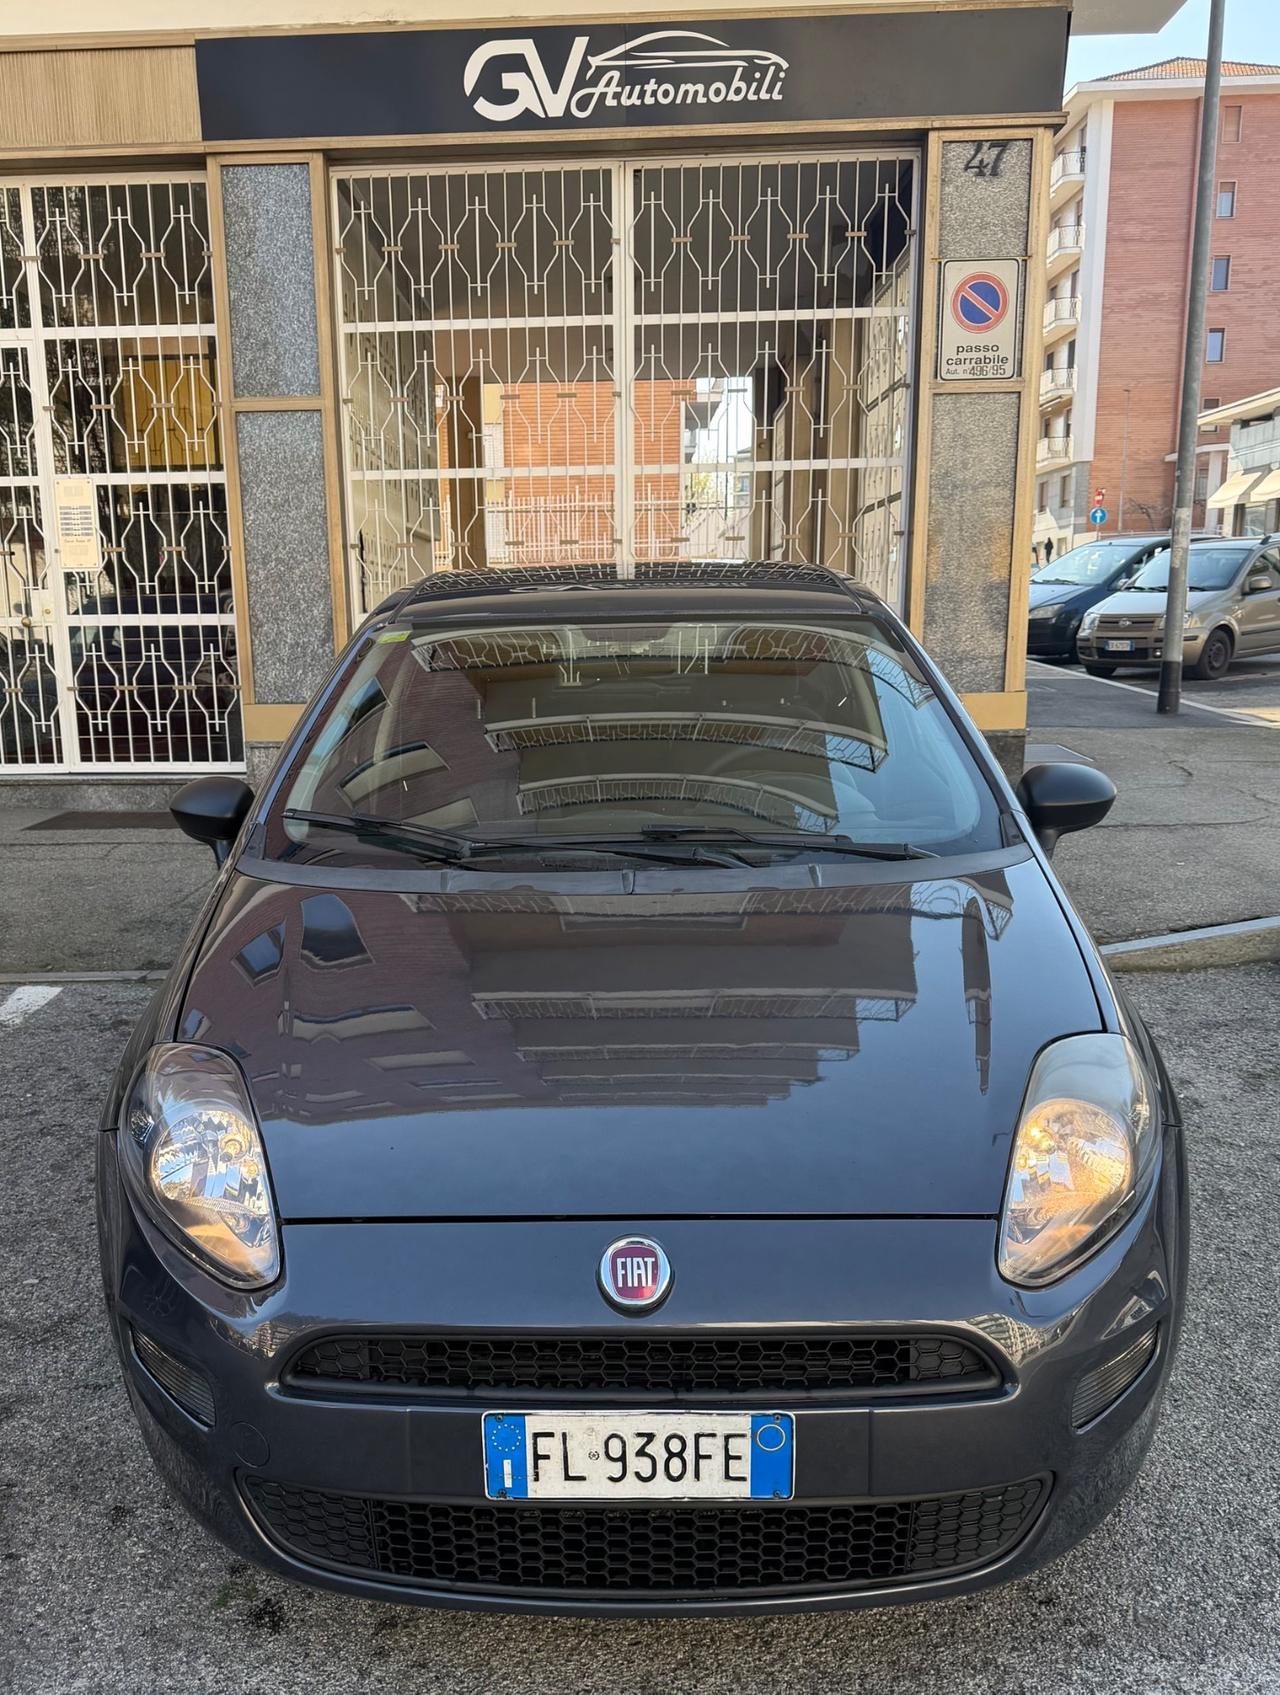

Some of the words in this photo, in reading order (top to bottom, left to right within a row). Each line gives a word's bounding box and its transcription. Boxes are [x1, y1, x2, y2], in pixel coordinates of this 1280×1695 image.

[463, 36, 590, 122] GV
[570, 65, 786, 119] Automobili
[963, 140, 1010, 176] 47
[946, 354, 1009, 365] carrabile
[956, 344, 1000, 355] passo
[616, 1257, 655, 1288] FIAT
[532, 1431, 587, 1482] FL
[604, 1431, 748, 1483] 938FE
